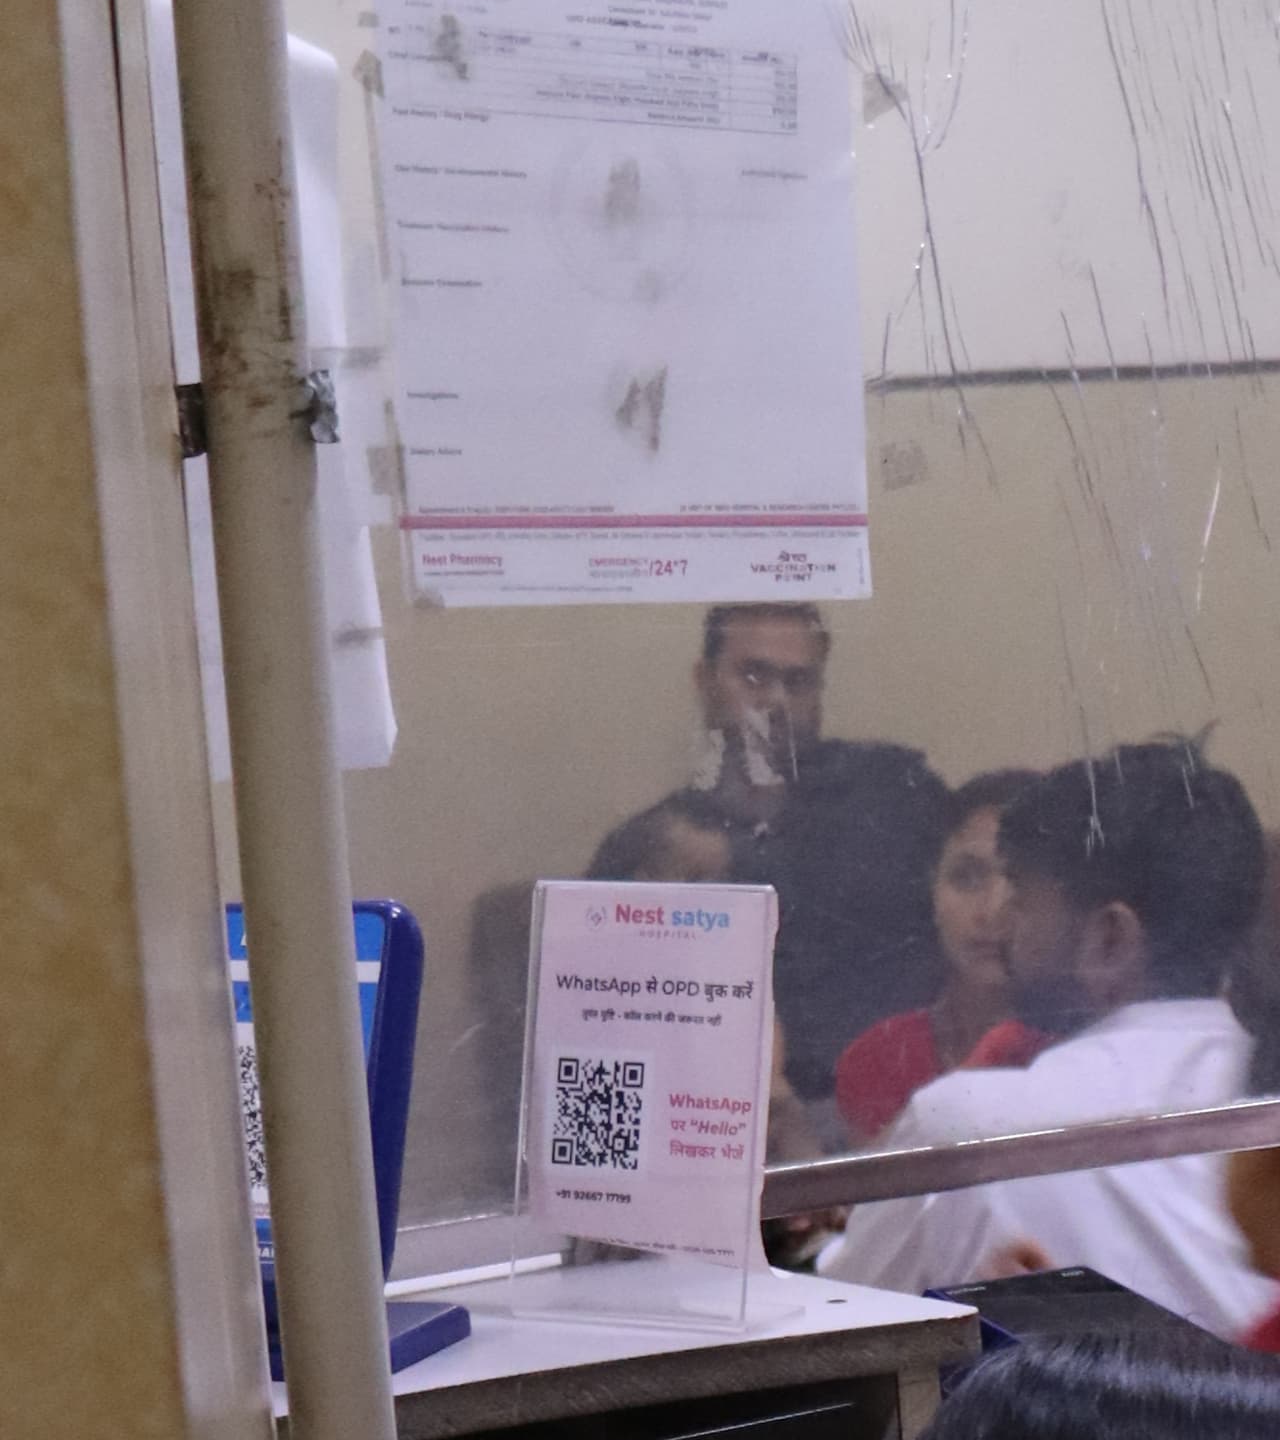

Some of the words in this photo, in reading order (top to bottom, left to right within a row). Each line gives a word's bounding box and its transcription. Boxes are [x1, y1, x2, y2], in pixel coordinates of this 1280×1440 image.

[615, 903, 664, 925] Nest
[671, 907, 730, 931] satya
[556, 975, 641, 997] WhatsApp
[662, 980, 699, 997] OPD
[704, 983, 729, 1002] बुक
[669, 1093, 752, 1115] WhatsApp
[670, 1118, 687, 1132] पर
